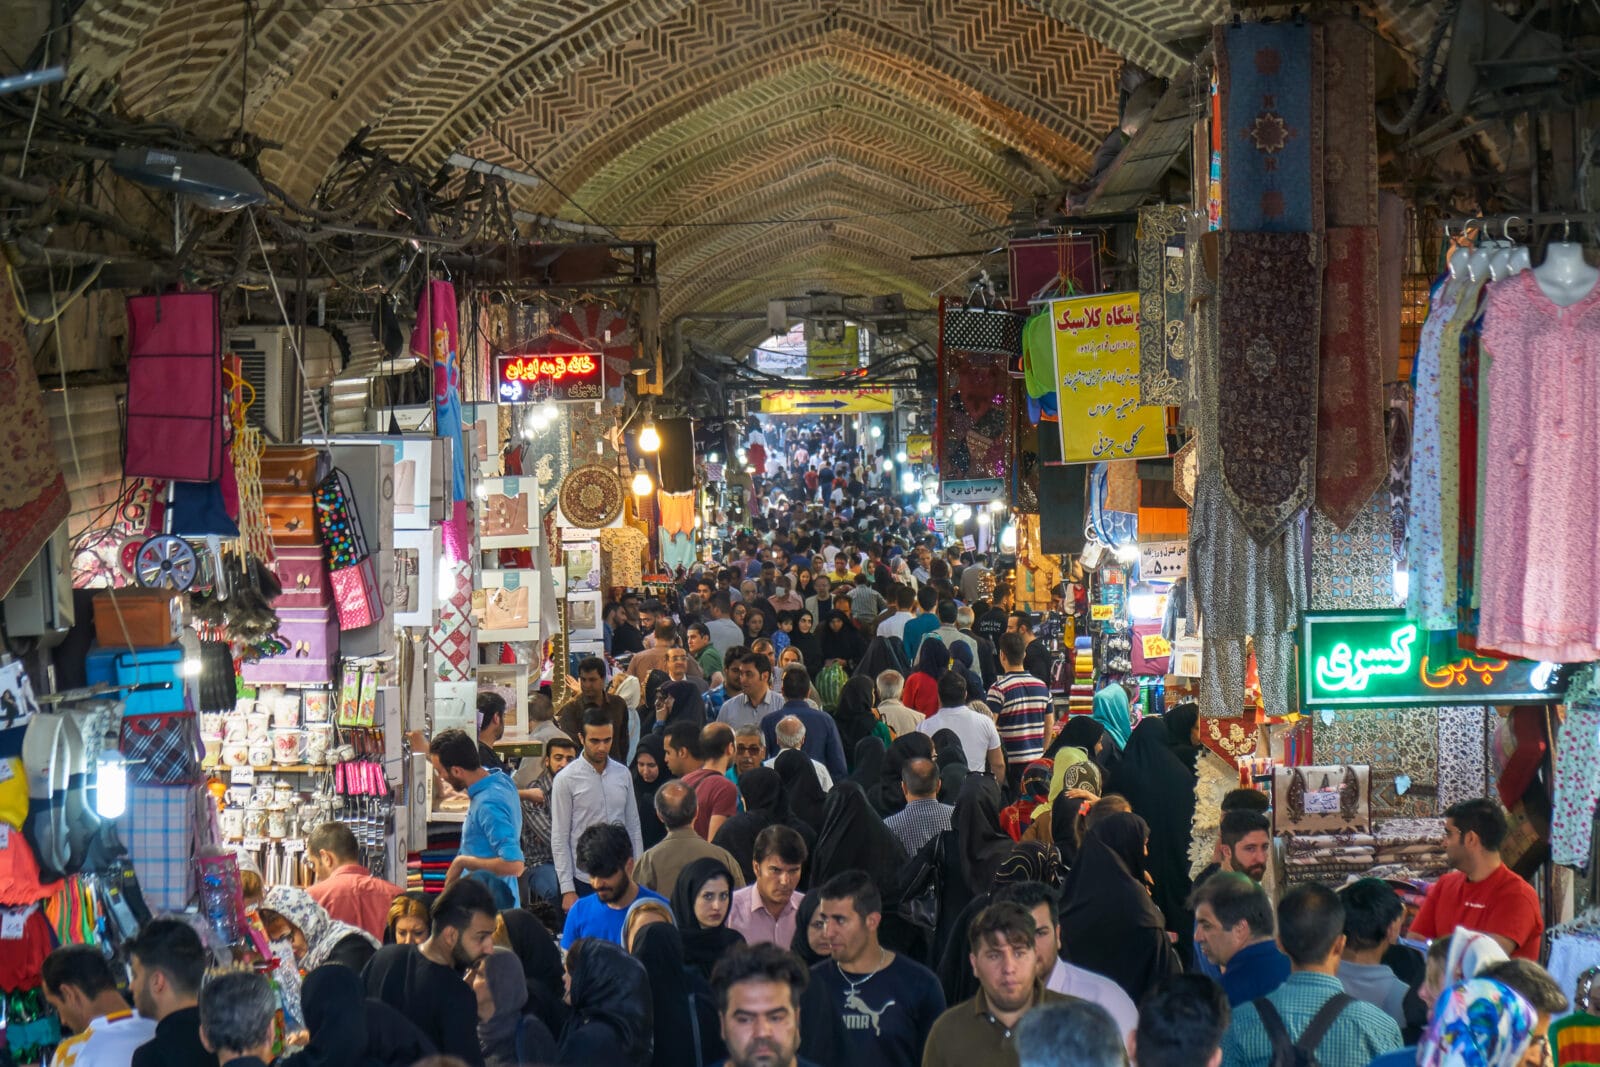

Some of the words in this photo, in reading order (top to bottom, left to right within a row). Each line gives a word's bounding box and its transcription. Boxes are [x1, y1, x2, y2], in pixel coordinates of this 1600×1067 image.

[1057, 307, 1102, 335] کلاسیک
[505, 358, 540, 380] ایران
[540, 357, 567, 379] ترمه
[567, 355, 596, 374] خانه
[1123, 425, 1145, 454] کلی
[1154, 560, 1181, 575] ۵۰۰۰
[1316, 623, 1417, 691] کسری
